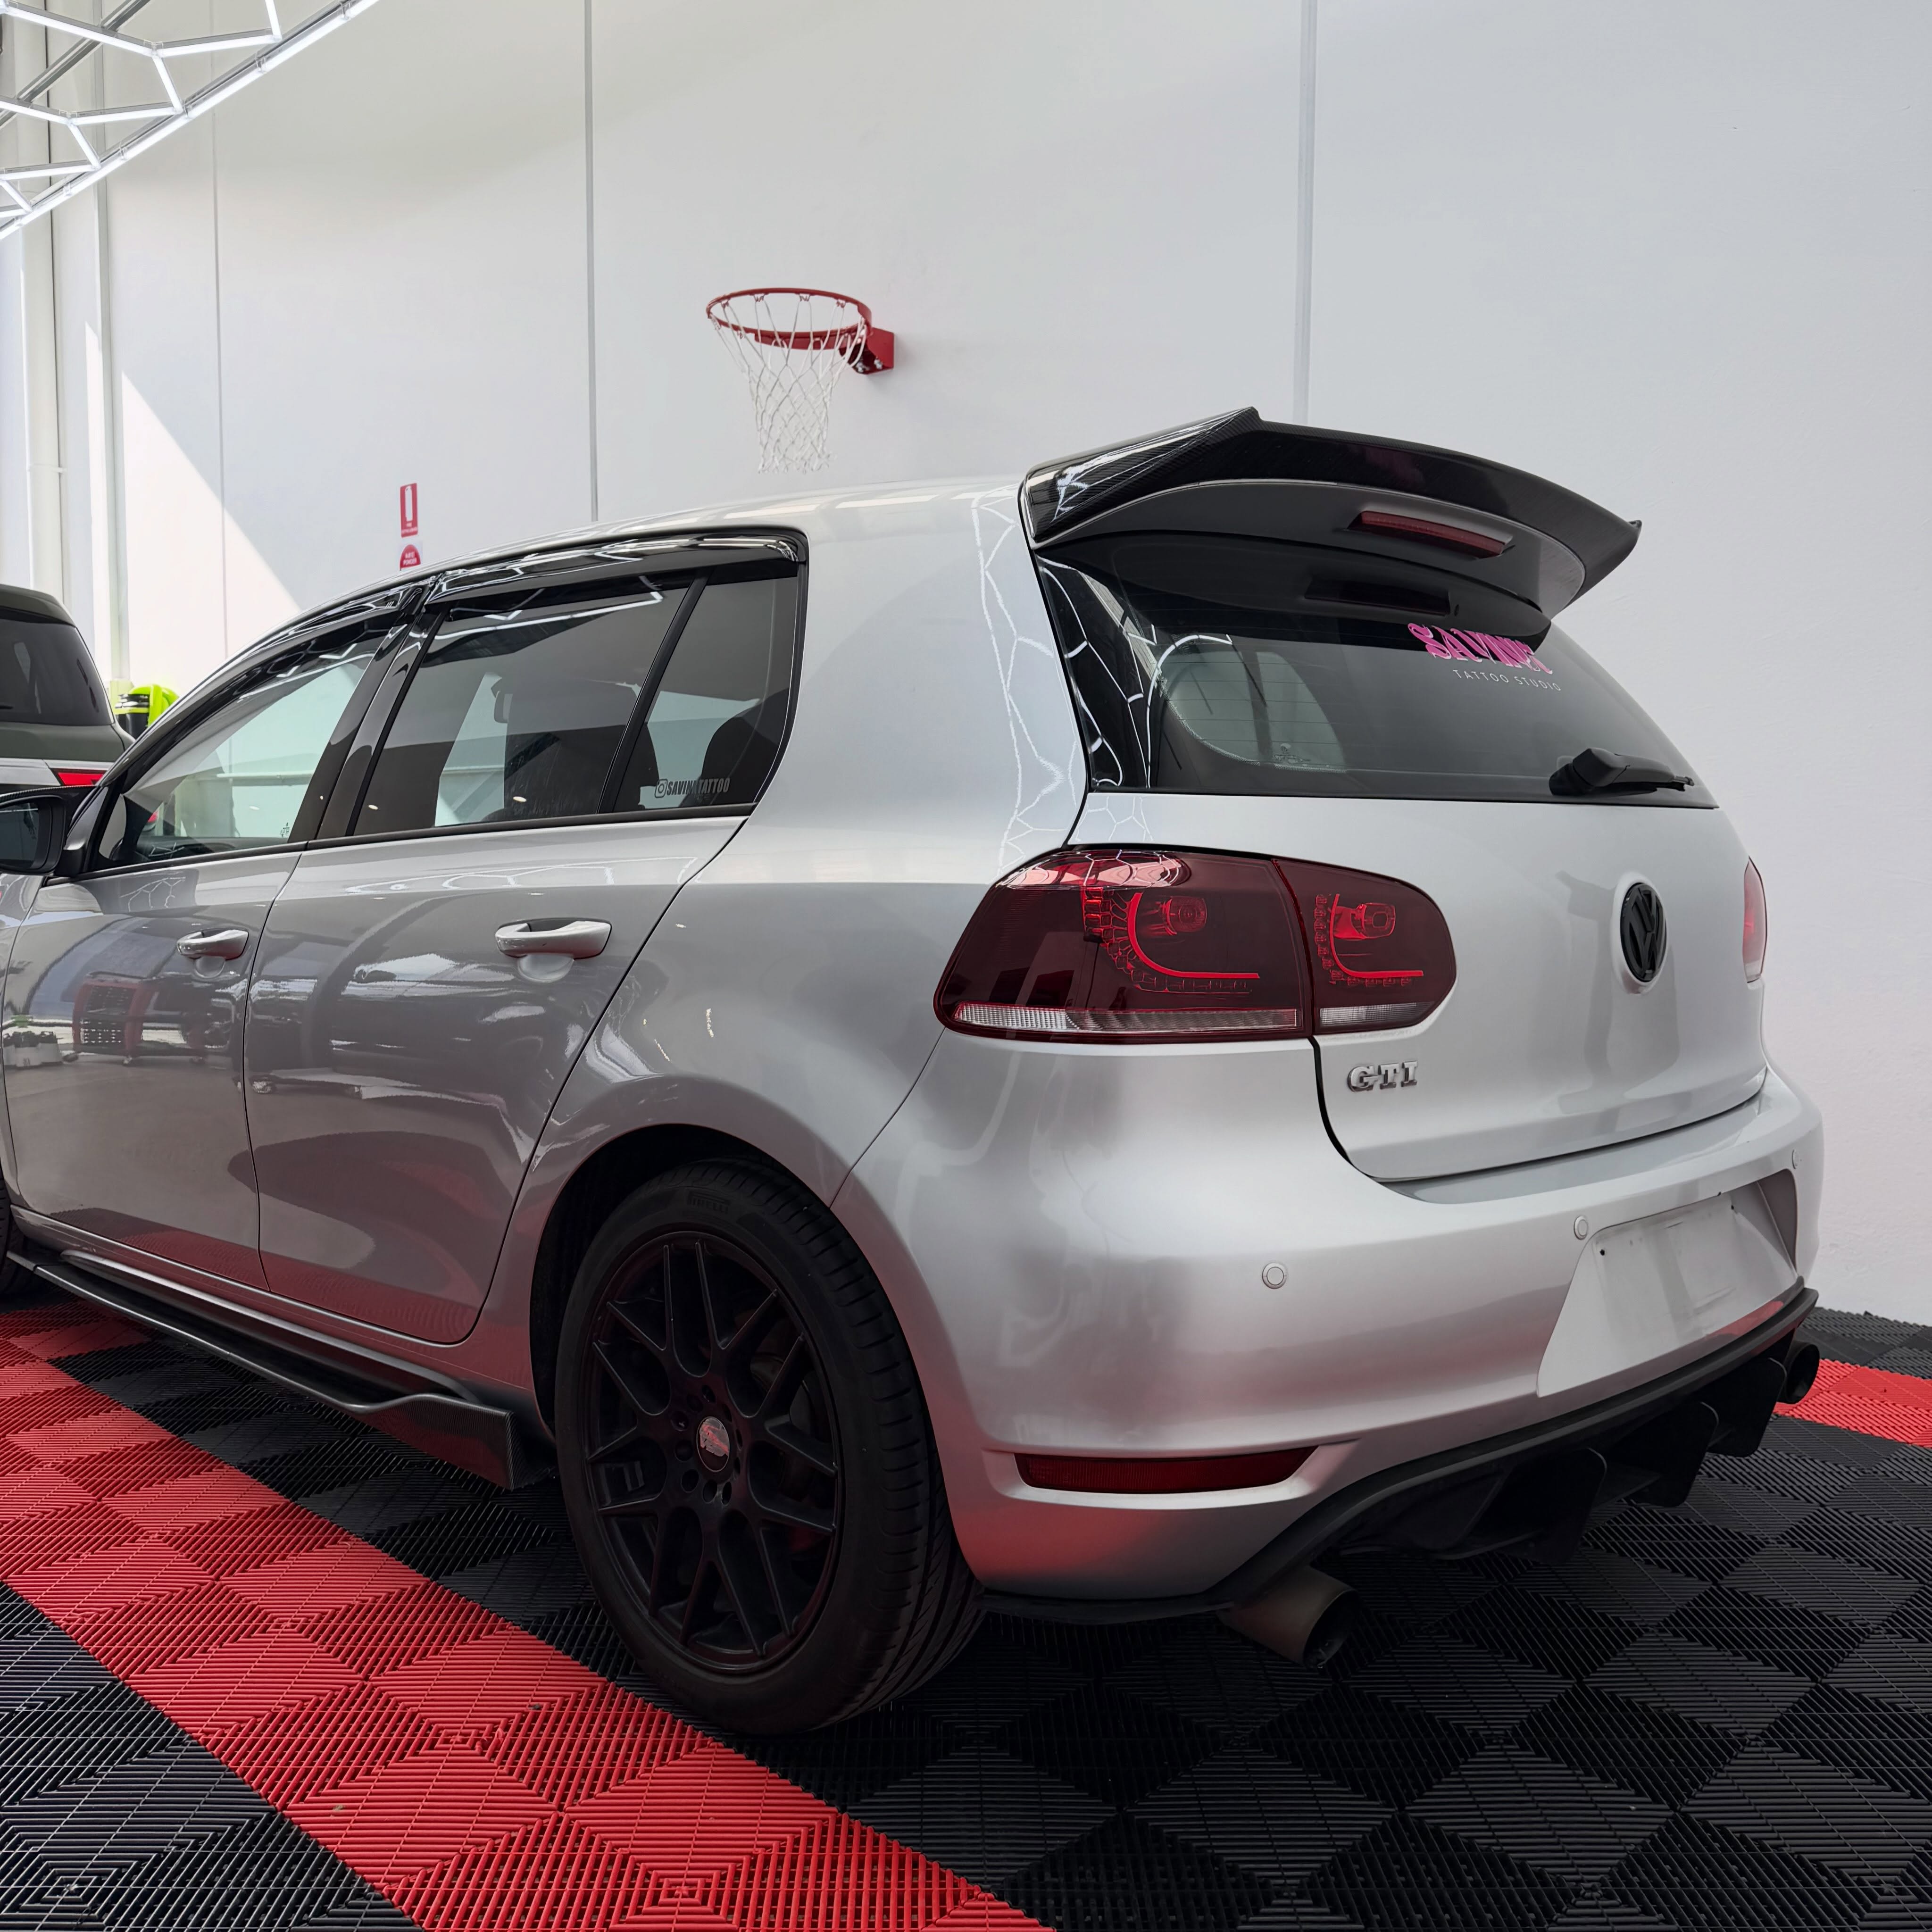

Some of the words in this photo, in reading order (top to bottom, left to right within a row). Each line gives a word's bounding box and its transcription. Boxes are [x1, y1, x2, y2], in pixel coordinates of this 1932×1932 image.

[1453, 669, 1509, 683] TATTOO
[1514, 675, 1561, 691] STUDIO
[1347, 1061, 1418, 1092] GTI
